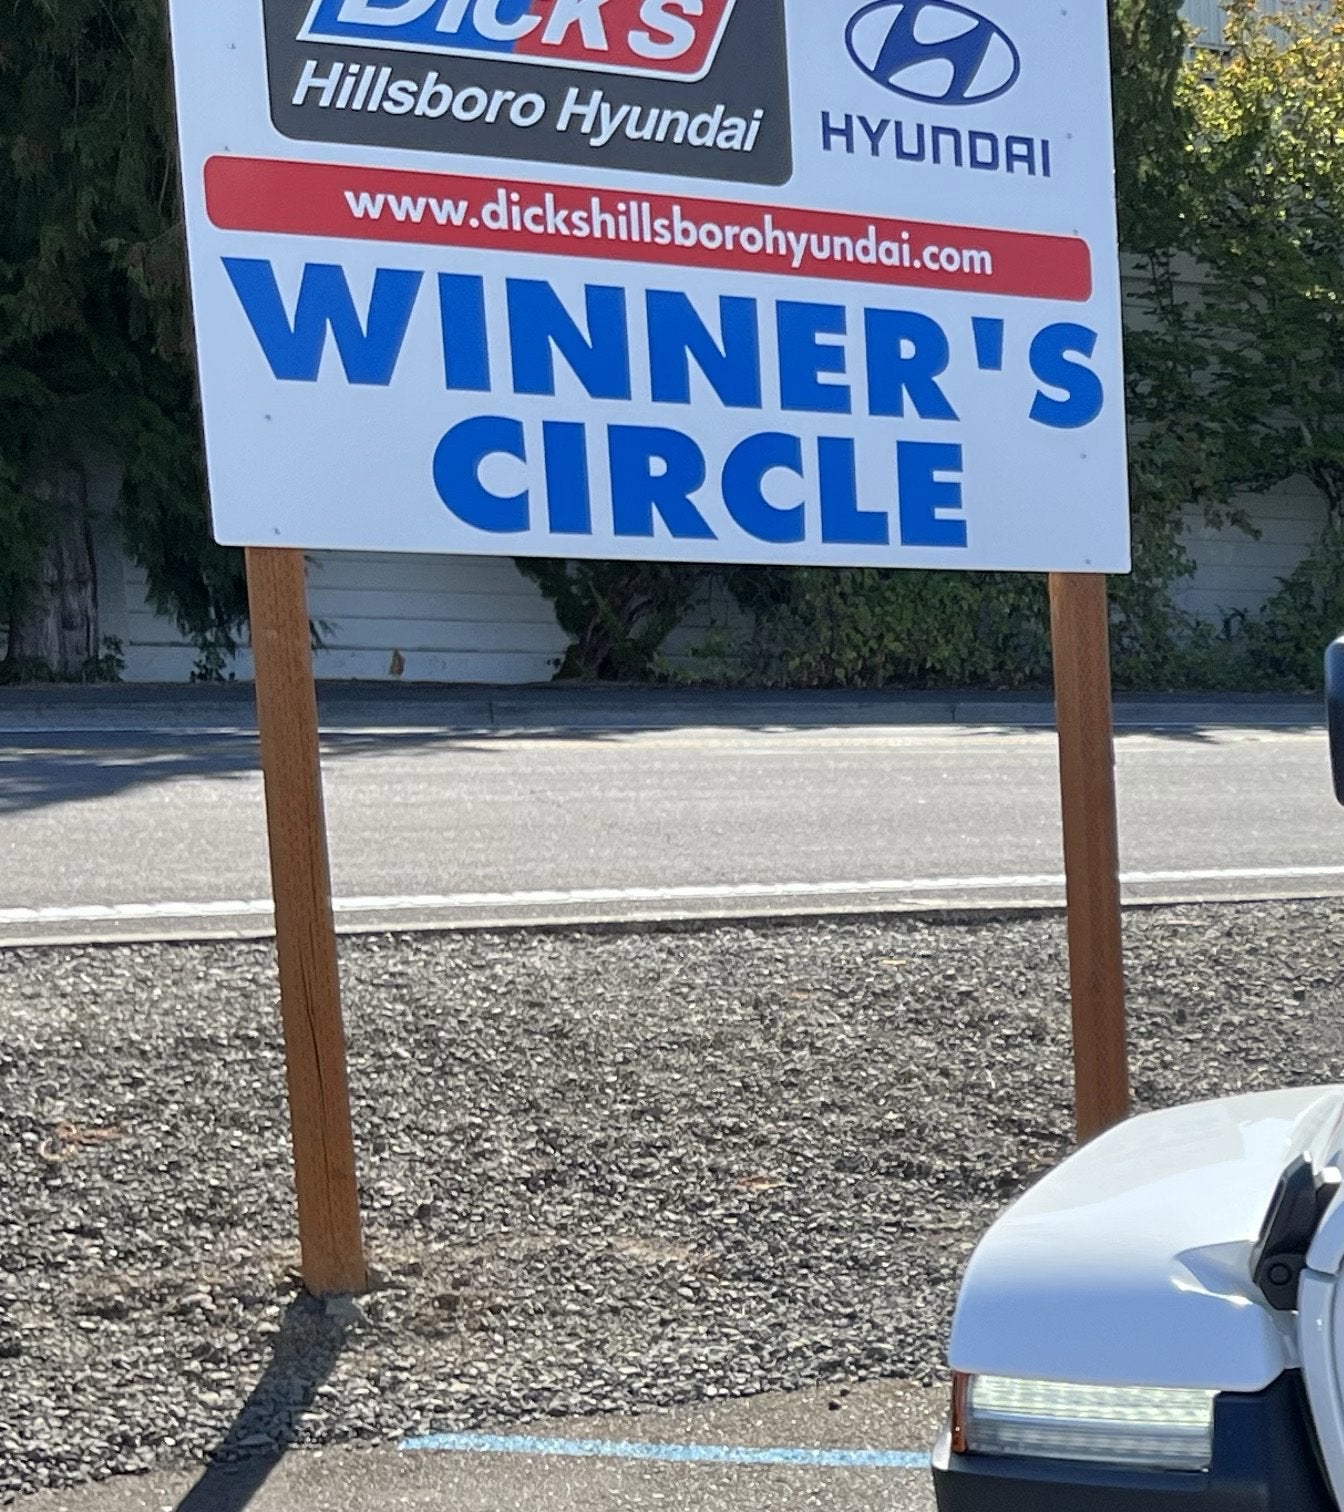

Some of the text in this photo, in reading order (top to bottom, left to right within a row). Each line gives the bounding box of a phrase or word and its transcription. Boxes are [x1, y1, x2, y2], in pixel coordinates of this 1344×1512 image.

[336, 0, 703, 60] cks
[292, 60, 764, 152] Hillsboro Hyundai
[821, 110, 1052, 178] HYUNDAI
[344, 188, 993, 276] www.dickshillsborohyundai.com
[220, 255, 1105, 430] WINNER'S
[432, 415, 969, 549] CIRCLE
